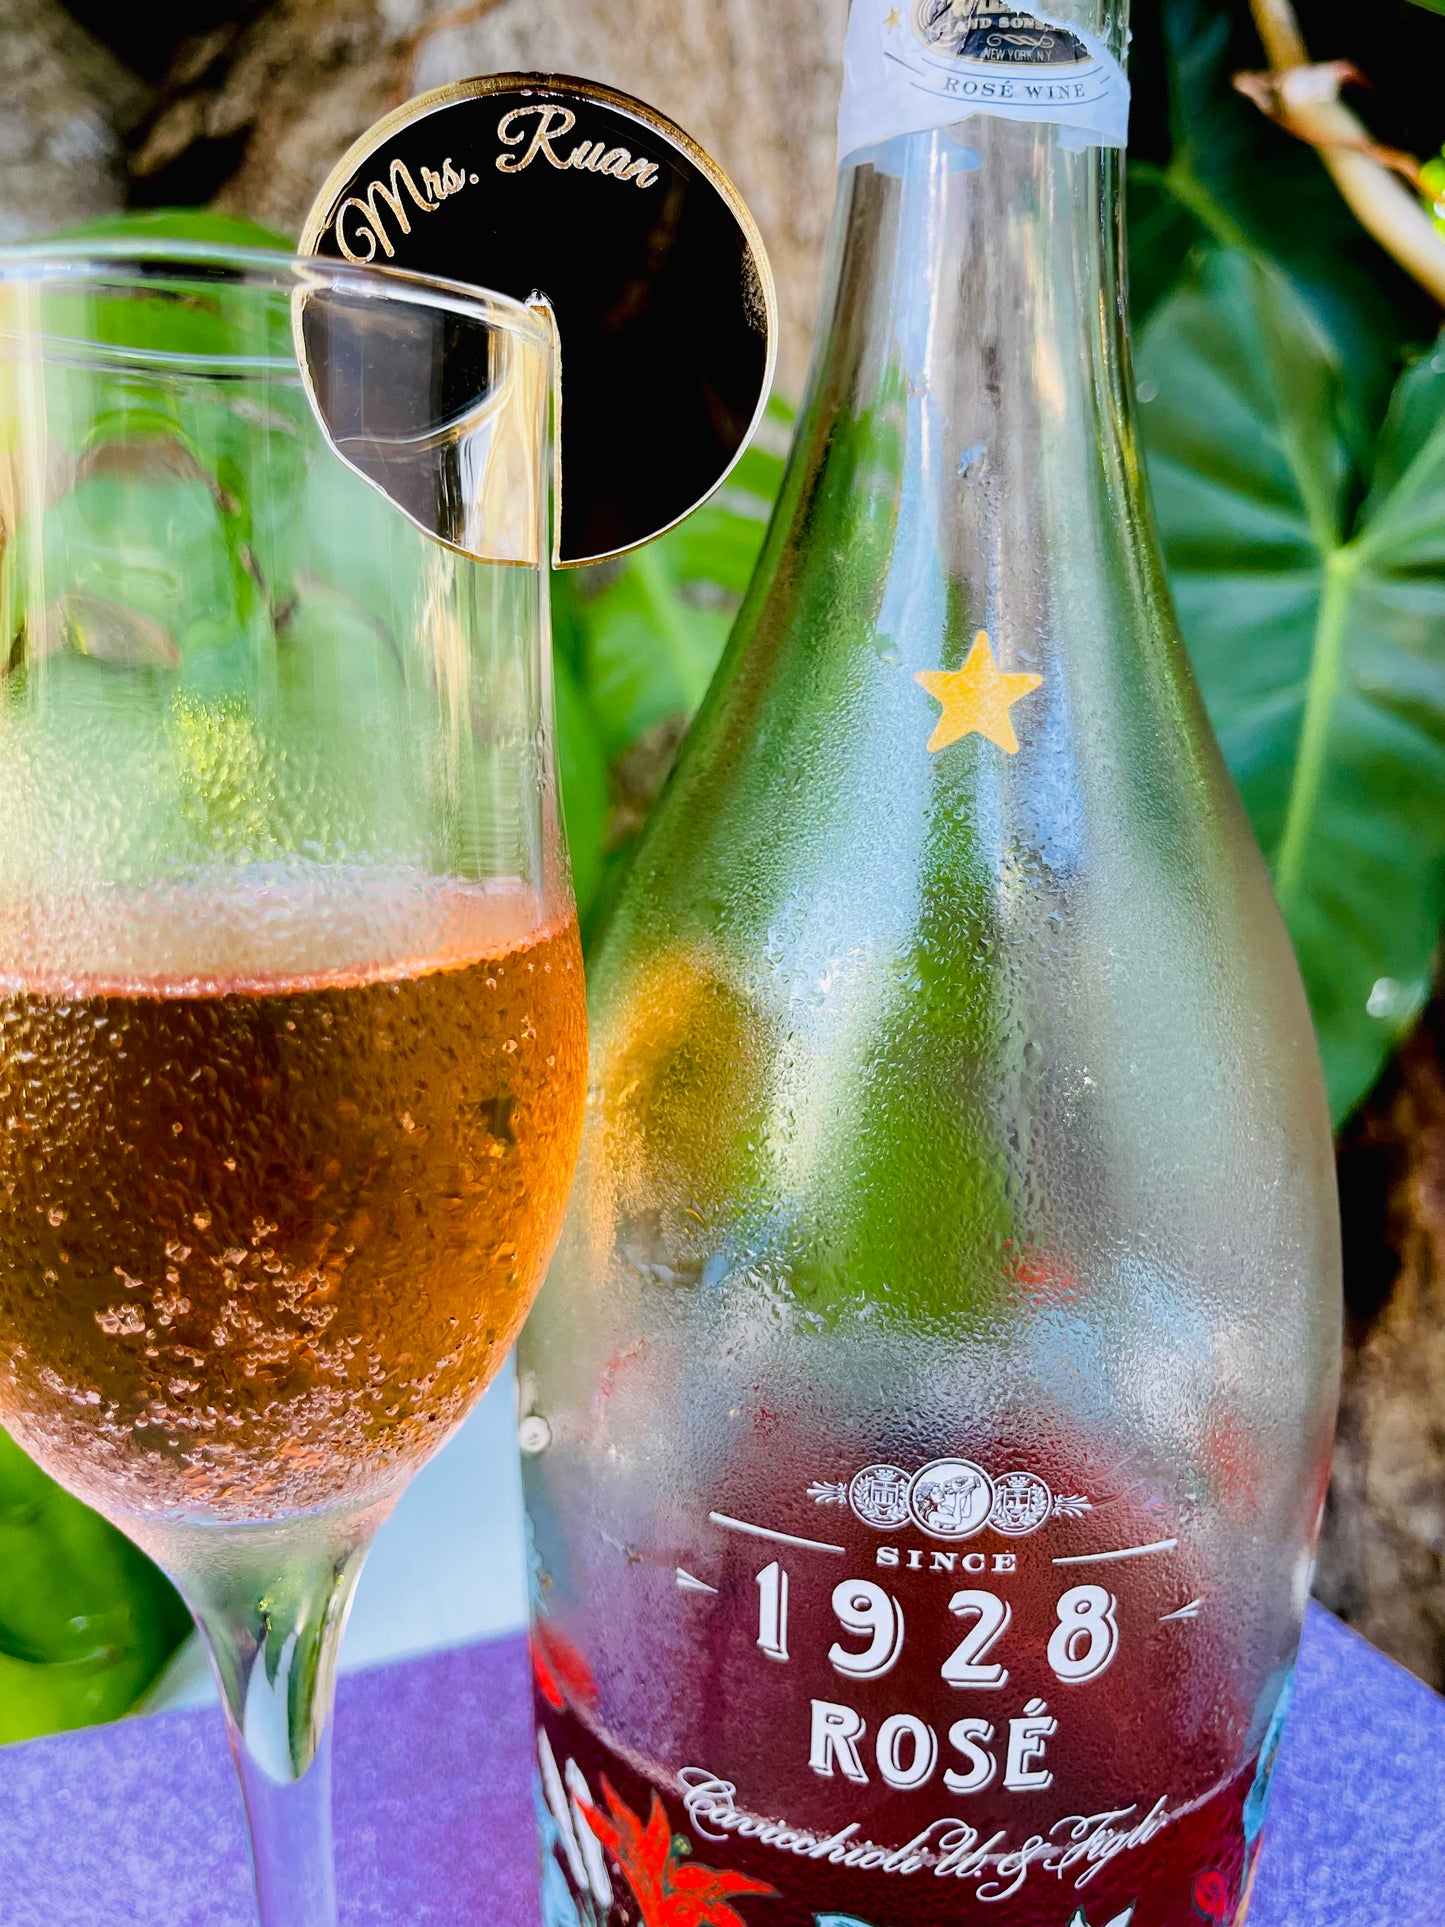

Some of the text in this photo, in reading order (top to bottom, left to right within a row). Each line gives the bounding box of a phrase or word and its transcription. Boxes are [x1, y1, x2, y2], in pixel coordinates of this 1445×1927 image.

[952, 16, 993, 33] AND
[983, 47, 1005, 61] NEW
[1006, 49, 1033, 61] YORK
[942, 76, 1086, 100] ROSÉ WINE
[335, 103, 660, 265] Mrs. Ruan
[875, 1546, 1017, 1573] SINCE
[755, 1560, 1120, 1689] 1928
[806, 1697, 1058, 1794] ROSÉ
[676, 1766, 931, 1875] Cavicchioli
[975, 1834, 1052, 1902] &
[1043, 1794, 1169, 1890] Figli
